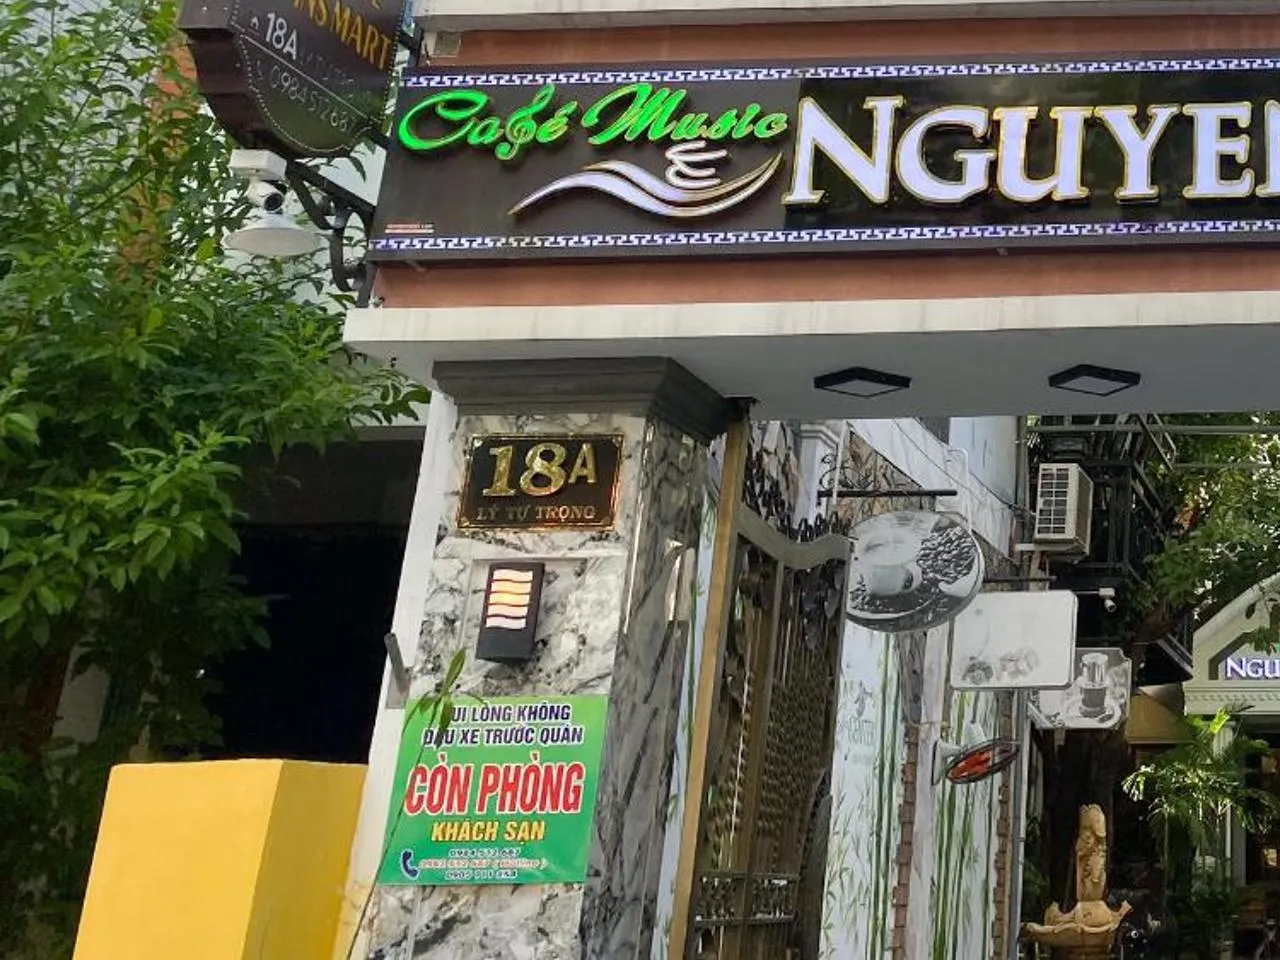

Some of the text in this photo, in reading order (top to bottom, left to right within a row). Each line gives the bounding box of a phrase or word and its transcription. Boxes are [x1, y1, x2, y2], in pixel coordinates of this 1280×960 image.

[265, 11, 298, 61] 18A
[398, 82, 789, 161] Café Music
[482, 442, 598, 497] 18A
[442, 700, 572, 723] UI LÒNG KHÔNG
[423, 727, 456, 747] ĐU
[459, 727, 480, 746] XE
[404, 750, 587, 816] CÒN PHÒNG
[431, 818, 546, 845] KHÁCH SẠN
